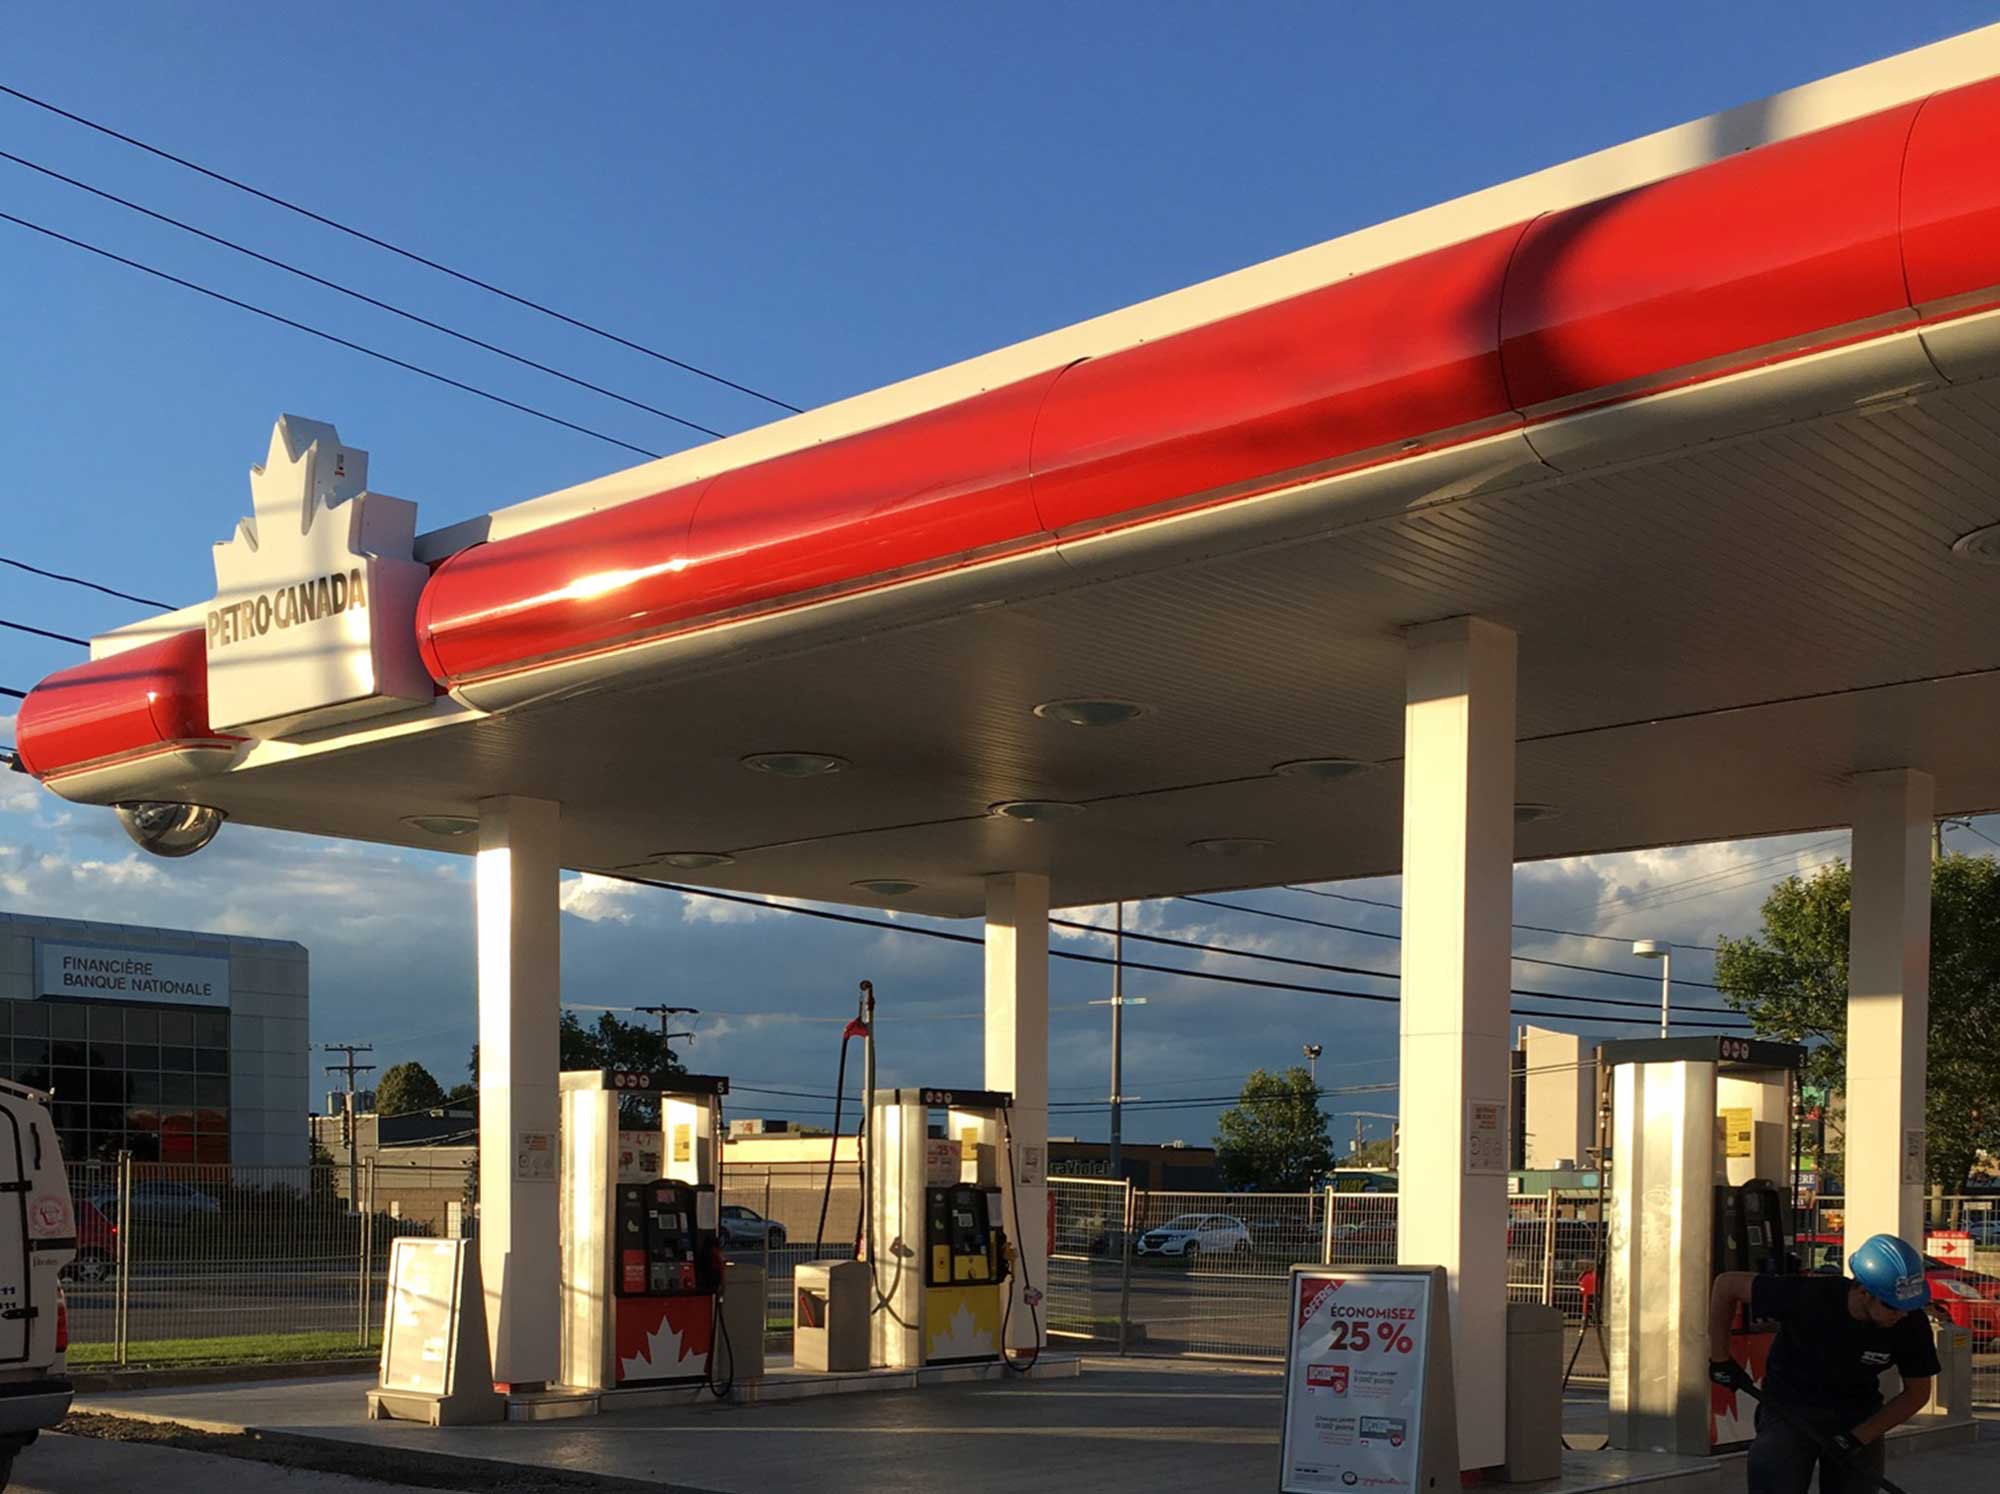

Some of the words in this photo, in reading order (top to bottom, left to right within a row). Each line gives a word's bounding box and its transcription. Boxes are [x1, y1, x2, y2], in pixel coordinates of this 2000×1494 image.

[63, 956, 153, 976] FINANCIÈRE
[63, 973, 126, 990] BANQUE
[131, 978, 213, 996] NATIONALE
[717, 1082, 725, 1094] 5
[1303, 1280, 1339, 1319] OFFRE!
[1330, 1302, 1417, 1320] ÉCONOMISEZ
[1328, 1320, 1371, 1352] 25
[1376, 1321, 1414, 1354] %
